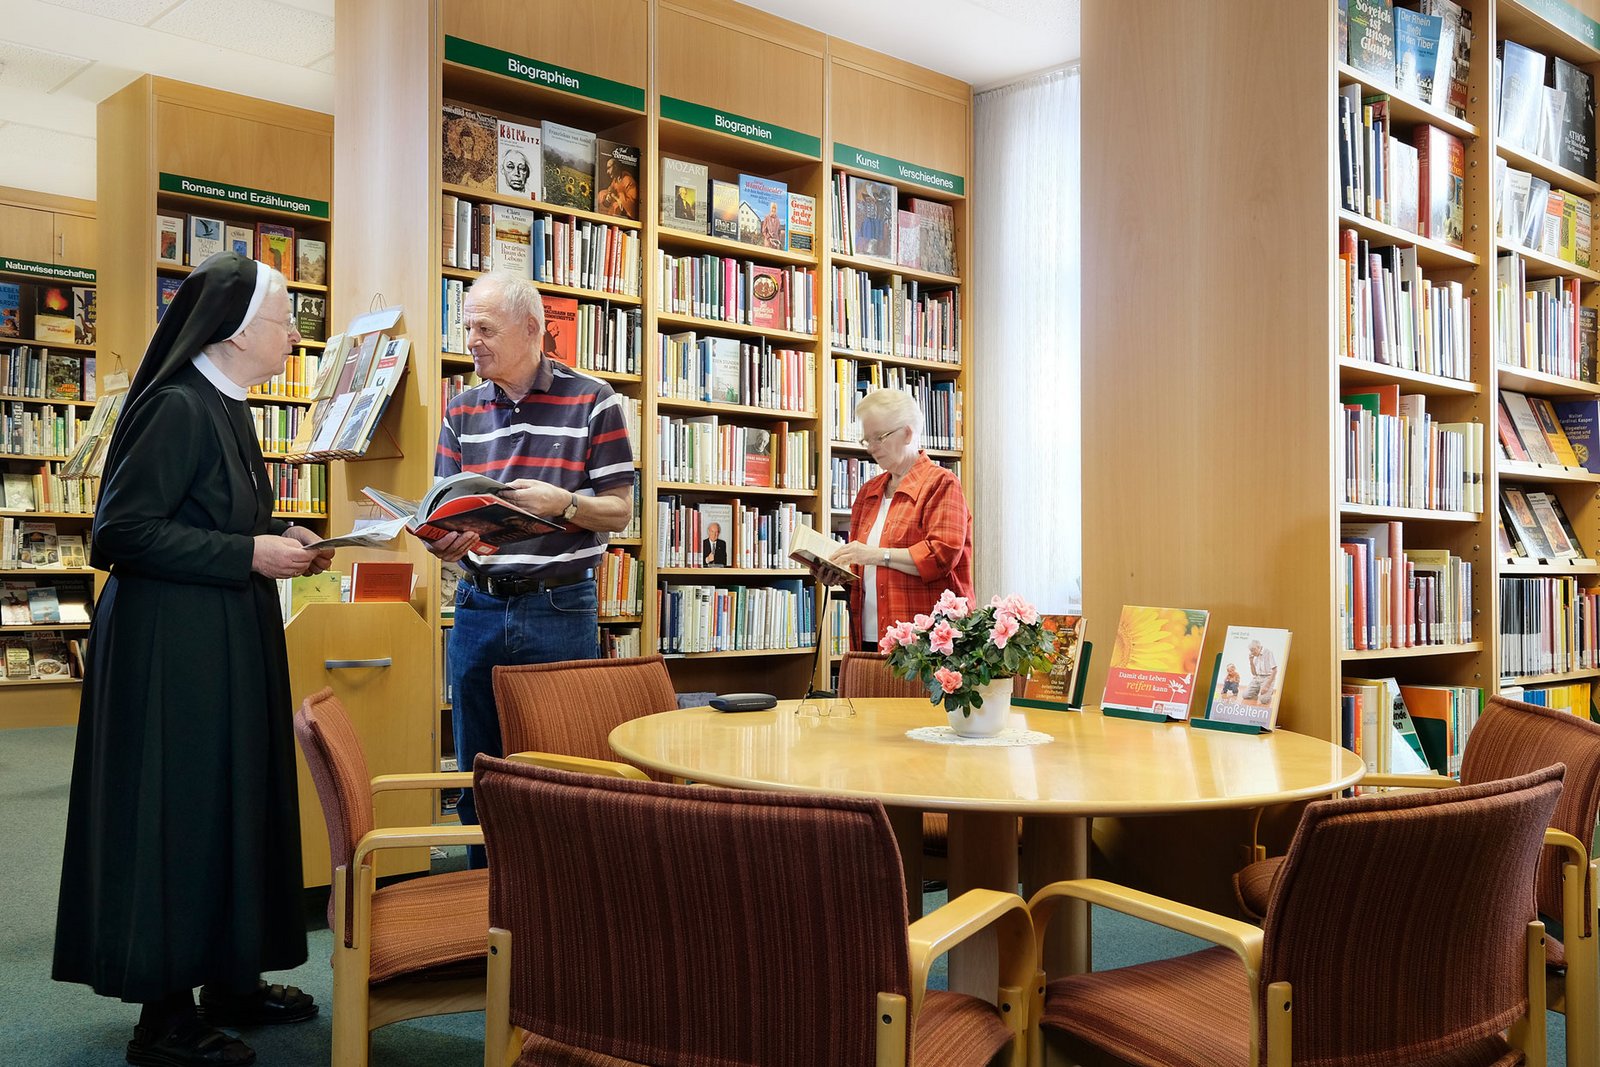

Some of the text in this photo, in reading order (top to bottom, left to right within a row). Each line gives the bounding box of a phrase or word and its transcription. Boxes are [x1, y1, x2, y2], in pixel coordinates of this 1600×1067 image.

[1368, 6, 1391, 24] reich
[1370, 18, 1382, 31] ist
[1365, 27, 1392, 46] unser
[1417, 36, 1434, 50] Tiber
[1360, 36, 1392, 60] Glaube
[508, 58, 580, 89] Biographien
[714, 114, 772, 140] Biographien
[500, 130, 540, 145] KOLLWITZ
[666, 159, 706, 177] MOZART
[856, 154, 880, 170] Kunst
[898, 165, 954, 189] Verschiedenes
[182, 180, 311, 212] Romane und Erzählungen
[791, 200, 812, 211] Genies
[791, 216, 812, 227] Schule
[801, 210, 811, 218] der
[5, 260, 95, 280] Naturwissenschaften
[1149, 674, 1166, 682] Leben
[1126, 681, 1152, 692] reifen
[1216, 703, 1268, 719] Großeltern
